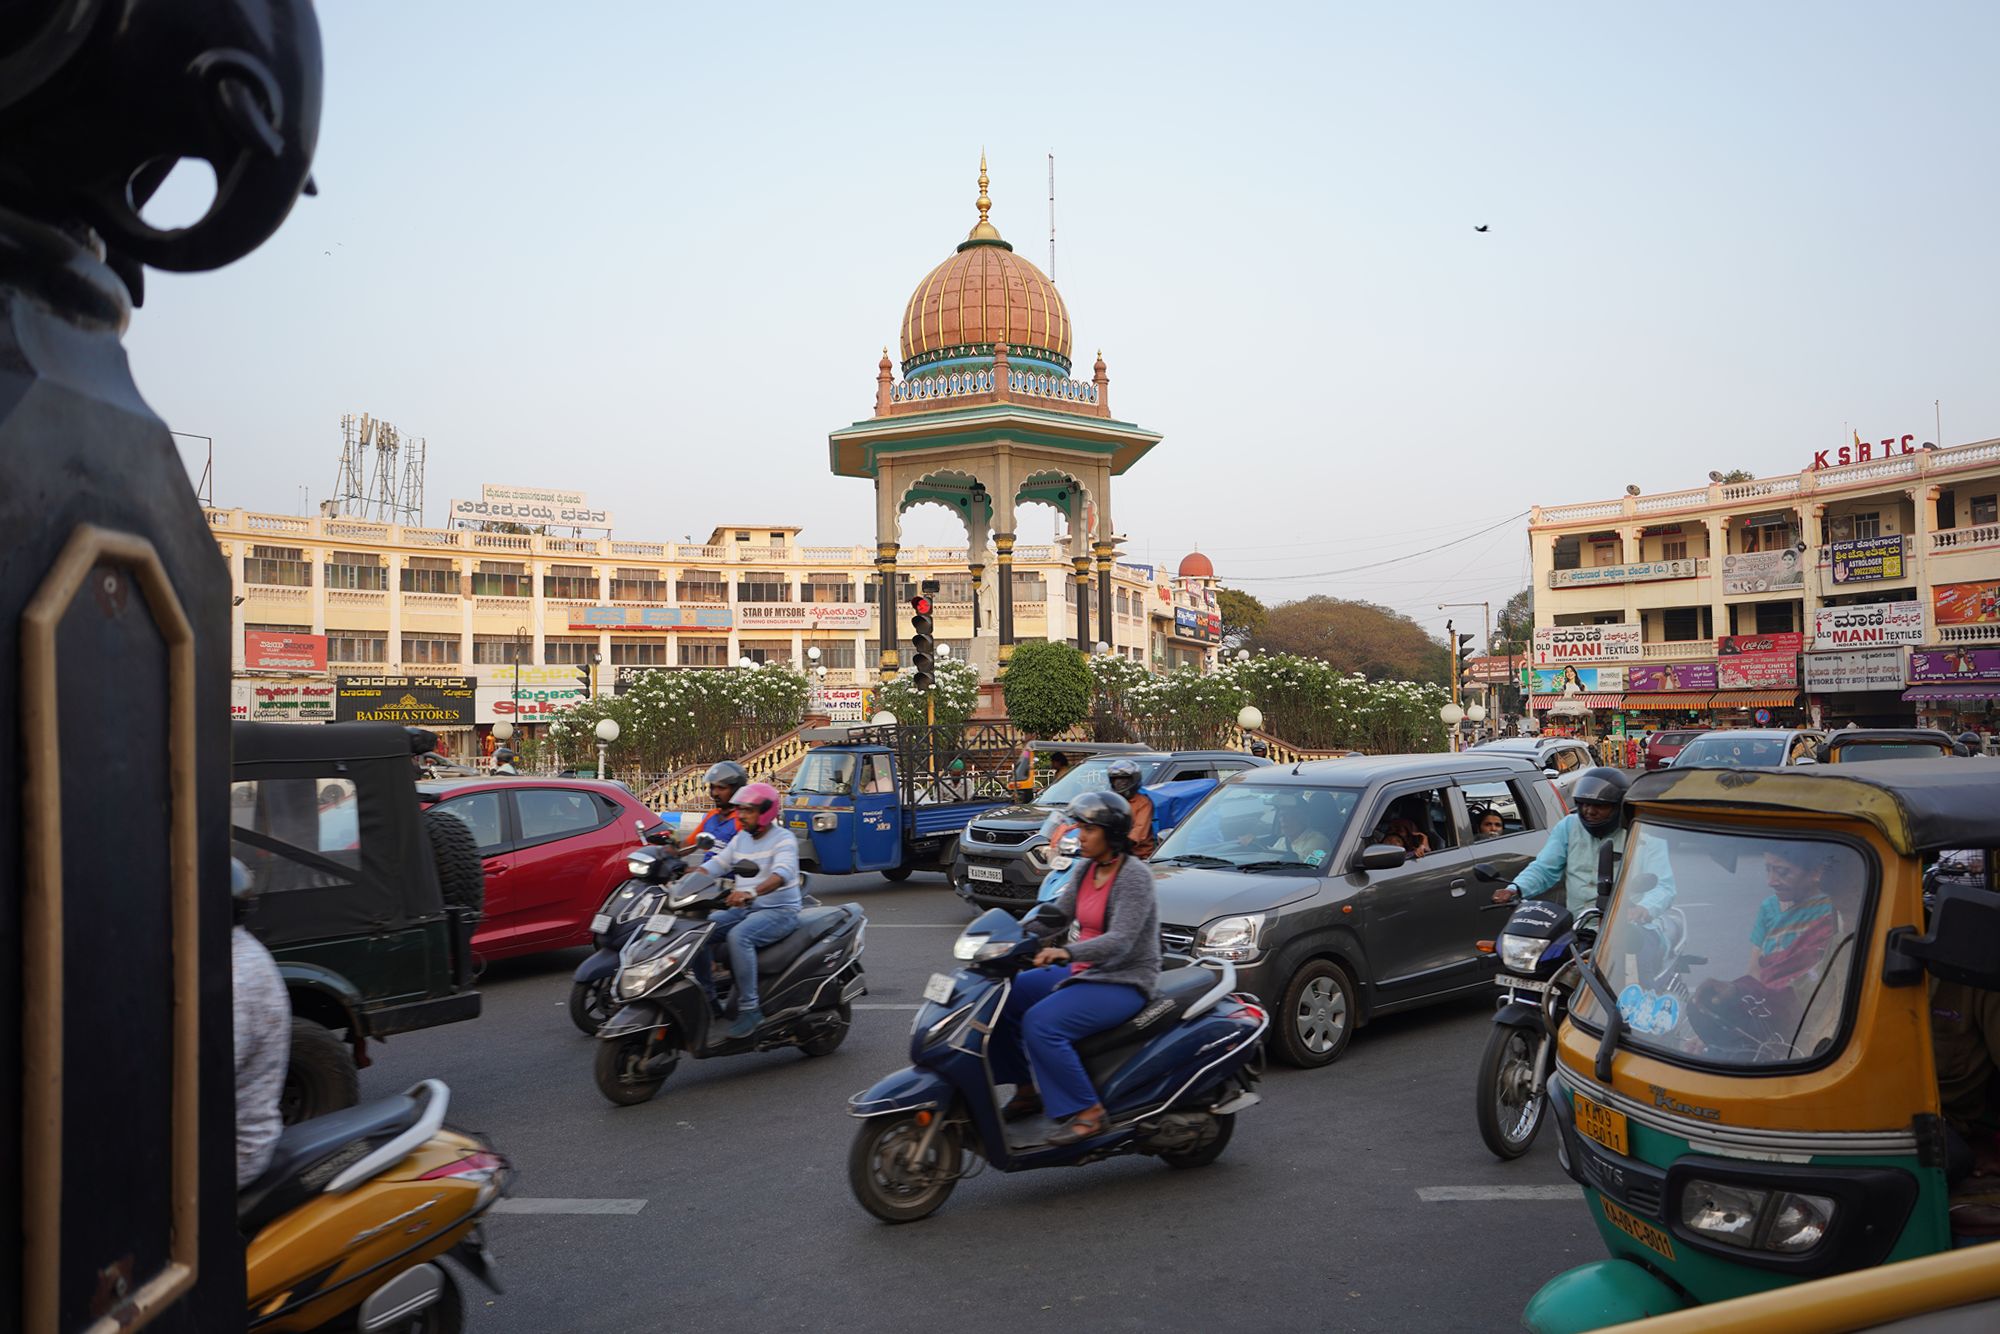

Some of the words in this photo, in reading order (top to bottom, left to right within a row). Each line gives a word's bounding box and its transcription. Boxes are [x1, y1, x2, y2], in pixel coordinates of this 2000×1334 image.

[1814, 434, 1915, 471] KSRTC
[743, 608, 762, 617] STAR
[764, 608, 774, 617] OF
[775, 608, 805, 617] MYSORE
[1834, 609, 1883, 628] ಮಾಣಿ
[1553, 628, 1602, 643] ಮಾಣಿ
[1832, 628, 1883, 643] MANI
[1885, 630, 1922, 640] TEXTILES
[1553, 643, 1601, 657] MANI
[356, 711, 410, 720] BADSHA
[411, 710, 460, 719] STORES
[1656, 1093, 1721, 1120] KING
